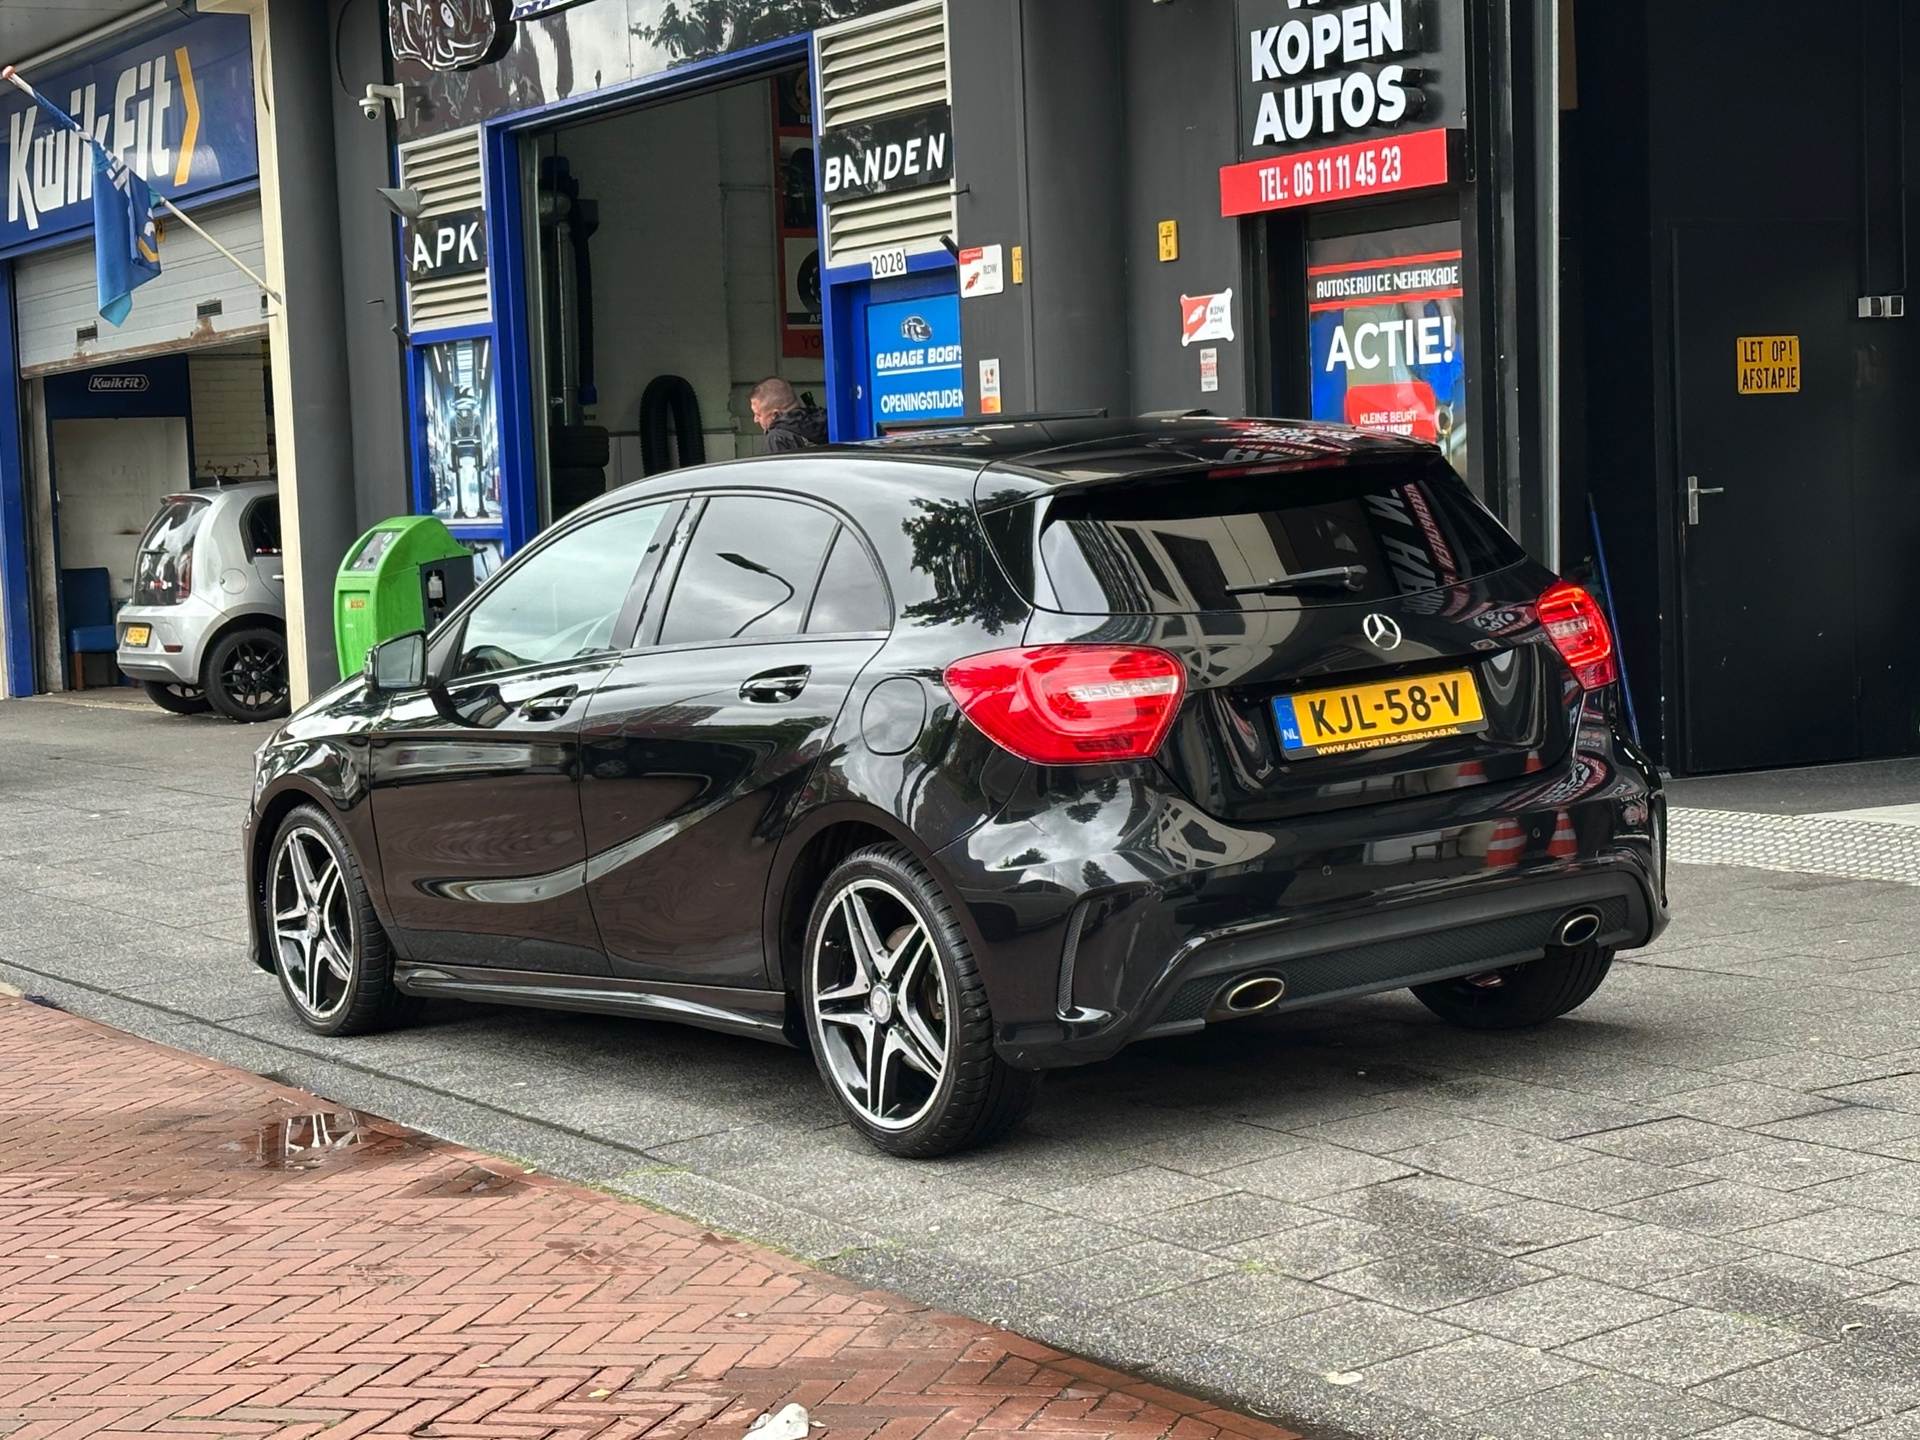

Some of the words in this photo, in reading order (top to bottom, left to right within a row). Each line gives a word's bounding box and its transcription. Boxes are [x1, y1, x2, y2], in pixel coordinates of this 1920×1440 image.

[1250, 1, 1404, 83] KOPEN
[1252, 65, 1407, 146] AUTOS
[824, 132, 946, 193] BANDEN
[1258, 166, 1289, 203] TEL:
[1293, 160, 1314, 198] 06
[1317, 157, 1332, 194] 11
[1335, 154, 1351, 191] 11
[1355, 150, 1377, 187] 45
[1381, 145, 1402, 184] 23
[412, 221, 479, 272] APK
[872, 252, 904, 276] 2028
[1316, 273, 1392, 299] AUTOSERVICE
[1393, 265, 1459, 291] NEHERKADE
[876, 348, 925, 370] GARAGE
[1325, 315, 1454, 372] ACTIE!
[1743, 340, 1764, 363] LET
[1771, 339, 1793, 362] OP!
[1742, 366, 1797, 390] AFSTAPJE
[1359, 411, 1389, 425] KLEINE
[1390, 409, 1418, 423] BEURT
[1308, 680, 1460, 737] KJL-58-V
[1283, 728, 1299, 741] NL
